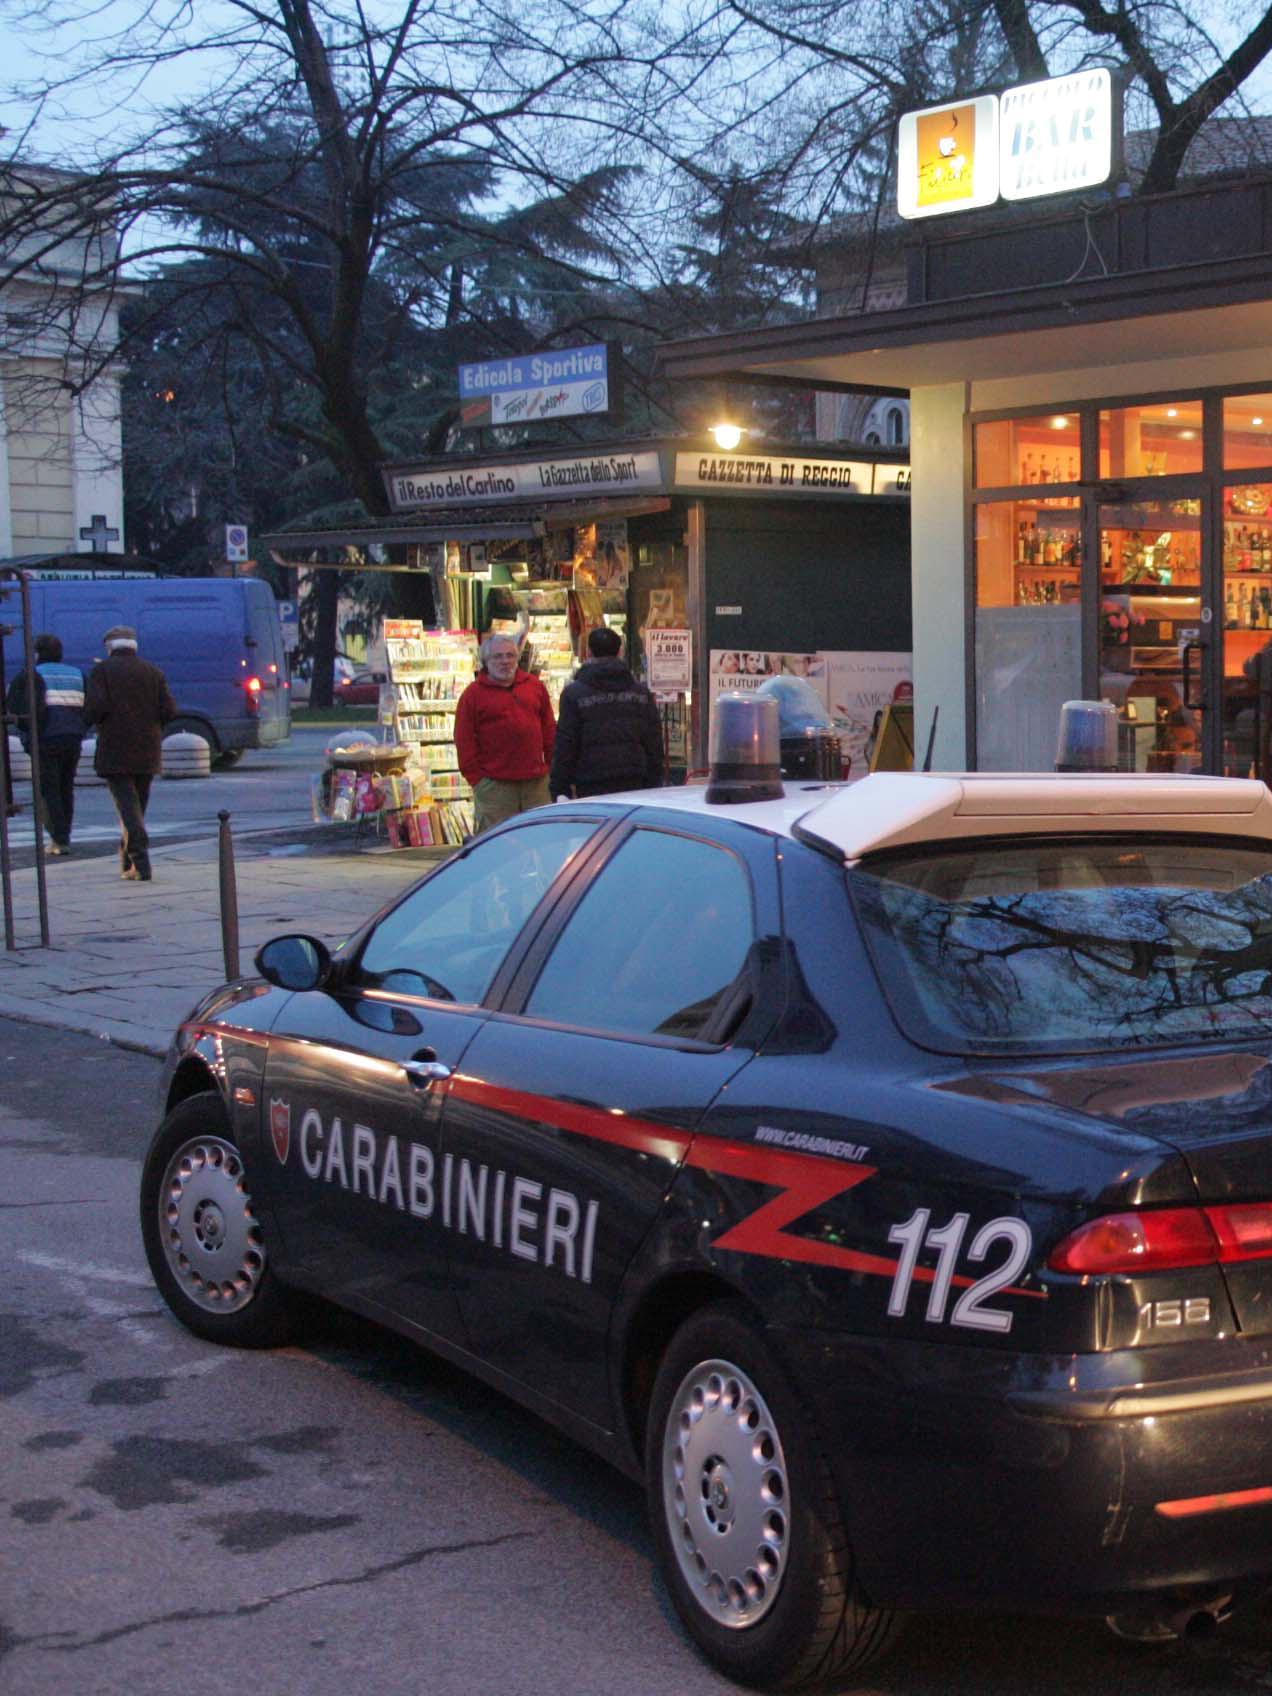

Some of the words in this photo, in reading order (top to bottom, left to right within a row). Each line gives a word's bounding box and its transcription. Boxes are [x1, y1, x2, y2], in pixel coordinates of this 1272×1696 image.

[1010, 106, 1096, 158] BAR
[463, 361, 523, 390] Edicola
[530, 351, 604, 385] Sportiva
[407, 480, 445, 499] Resto
[445, 476, 465, 497] del
[466, 473, 515, 497] Carlino
[539, 466, 550, 488] La
[550, 462, 590, 486] Gazzetta
[590, 460, 612, 482] dello
[611, 457, 637, 485] Sport
[698, 458, 773, 485] GAZZETTA
[779, 463, 795, 486] DI
[801, 464, 851, 488] REGGIO
[279, 602, 294, 621] P
[718, 677, 727, 689] IL
[300, 1107, 599, 1284] CARABINIERI
[887, 1207, 1032, 1333] 112
[1140, 1297, 1211, 1328] 156
